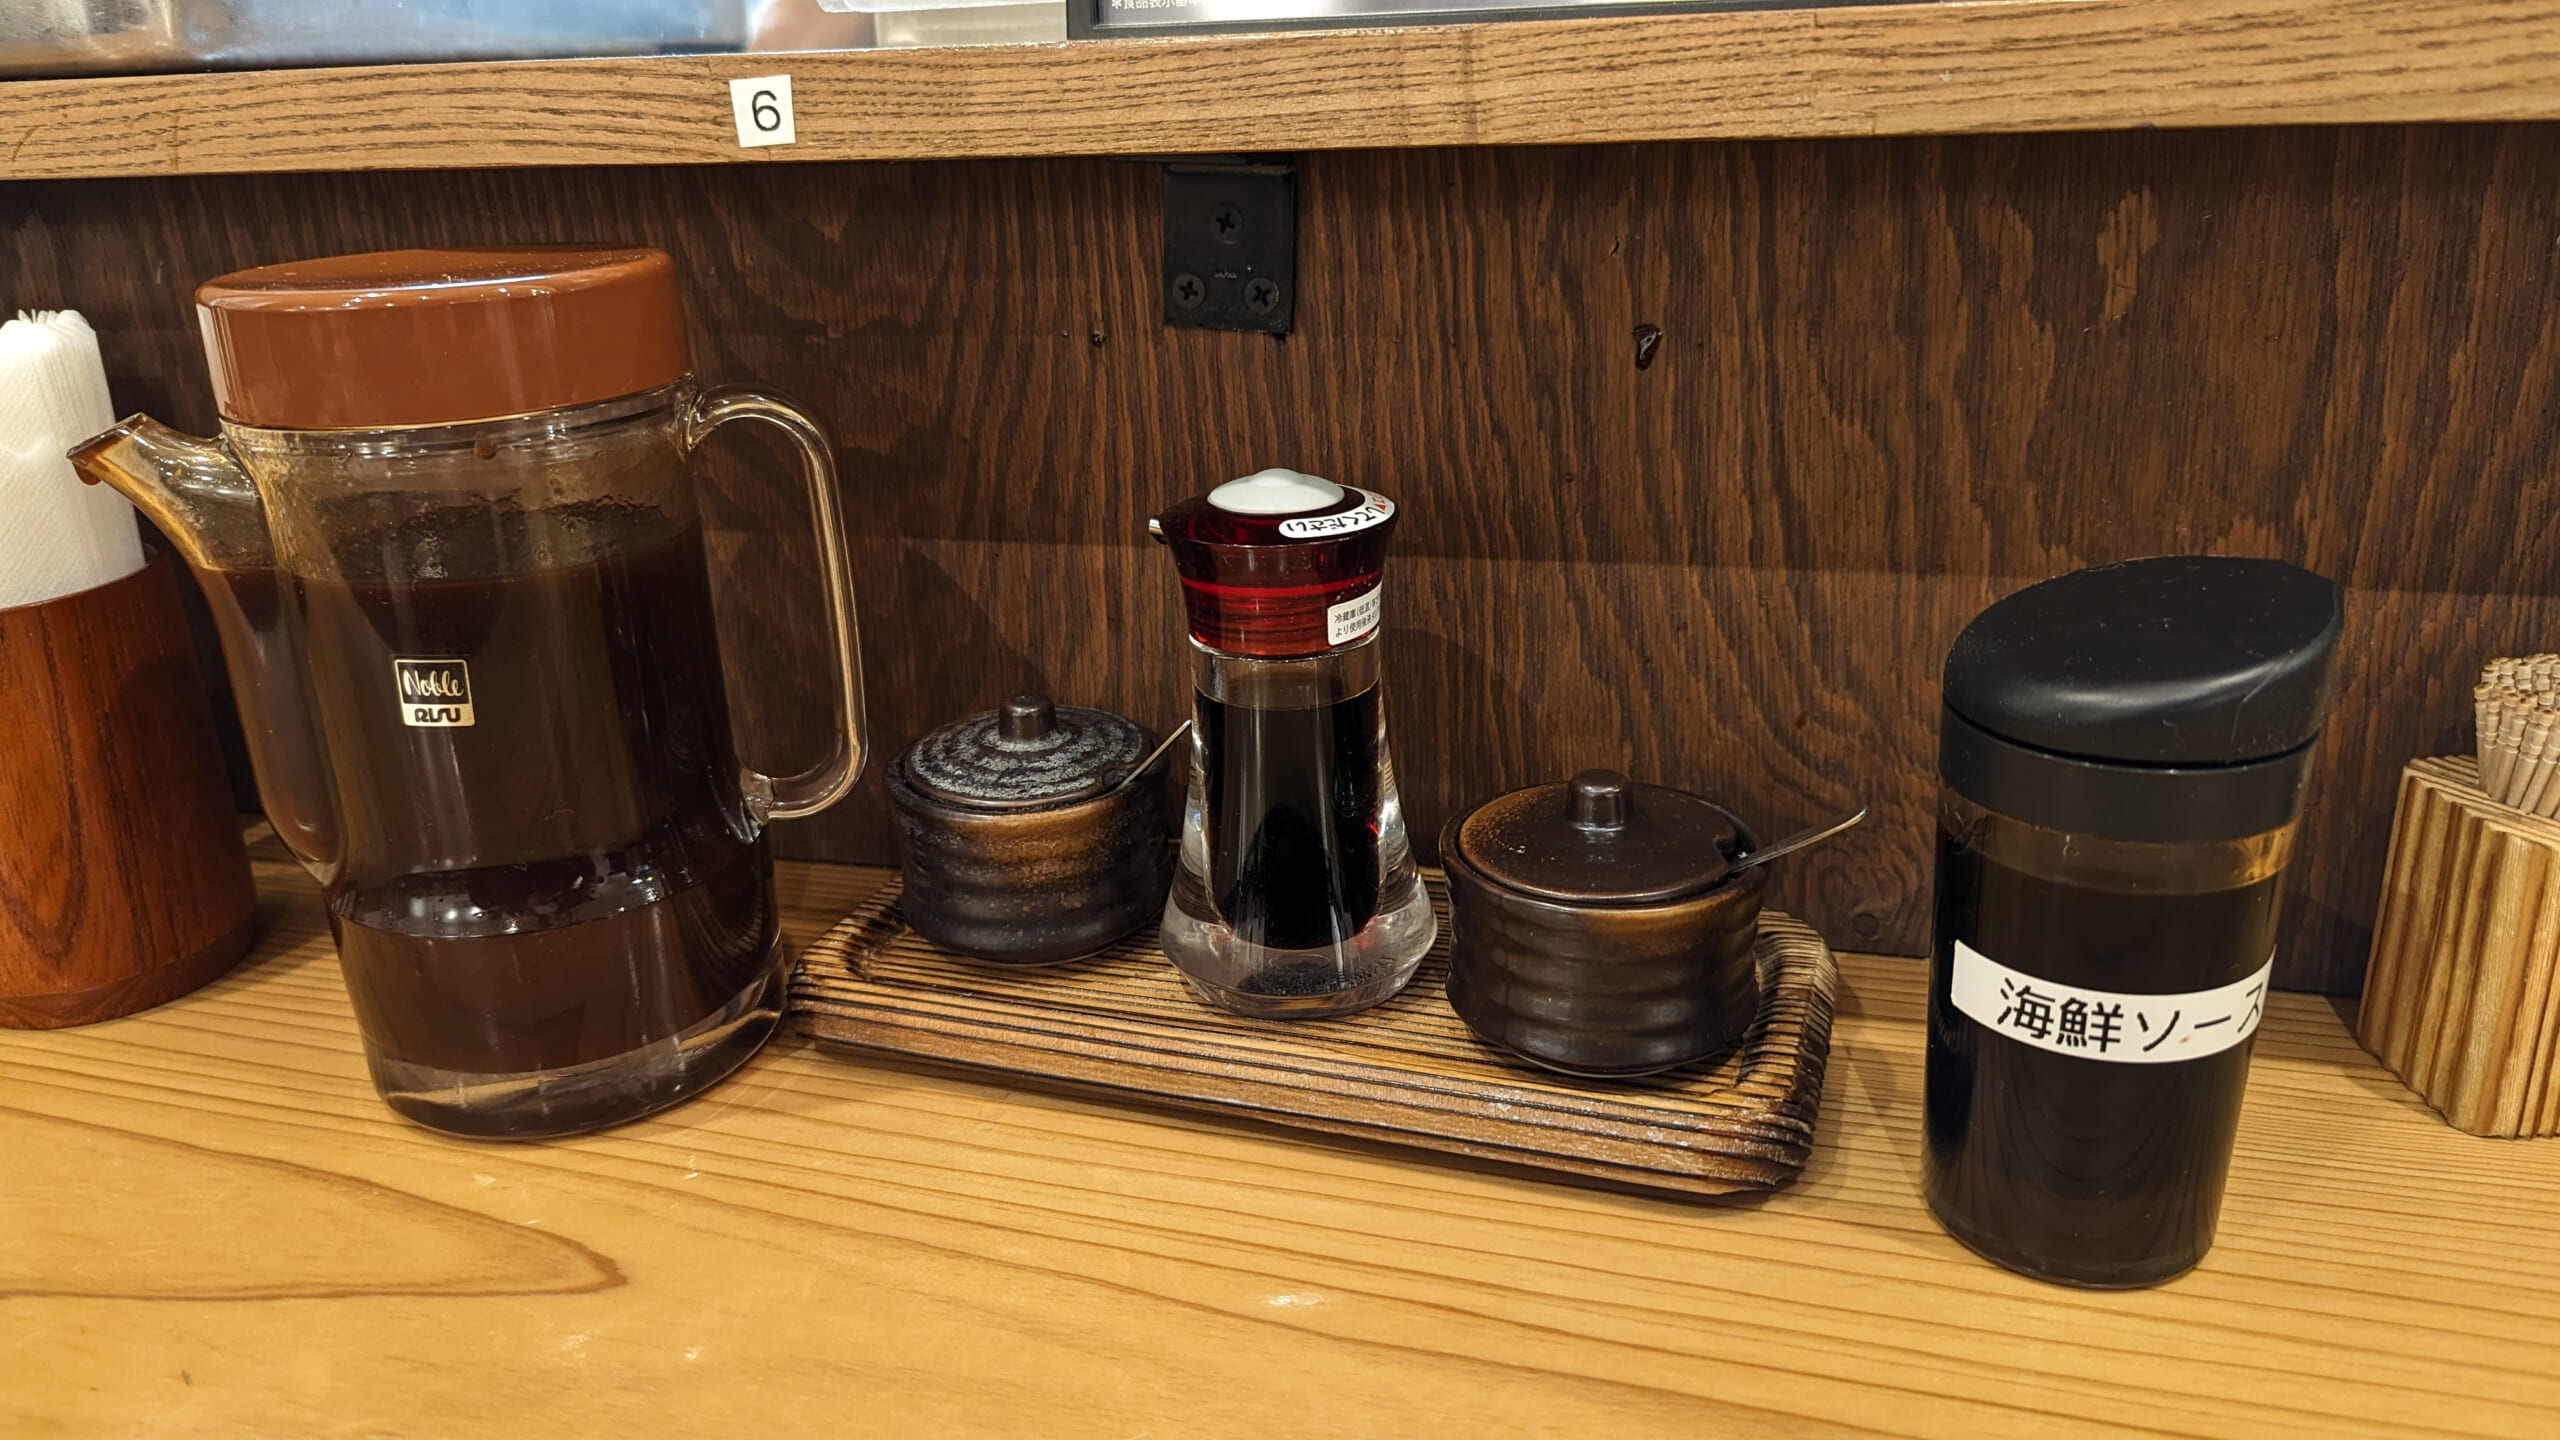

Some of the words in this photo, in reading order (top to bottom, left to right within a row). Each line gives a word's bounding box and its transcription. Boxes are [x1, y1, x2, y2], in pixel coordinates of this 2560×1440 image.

[751, 90, 781, 131] 6
[1286, 506, 1386, 532] してください
[403, 669, 464, 697] Noble
[414, 707, 461, 723] RISU
[1997, 977, 2264, 1053] 海鮮ソース
